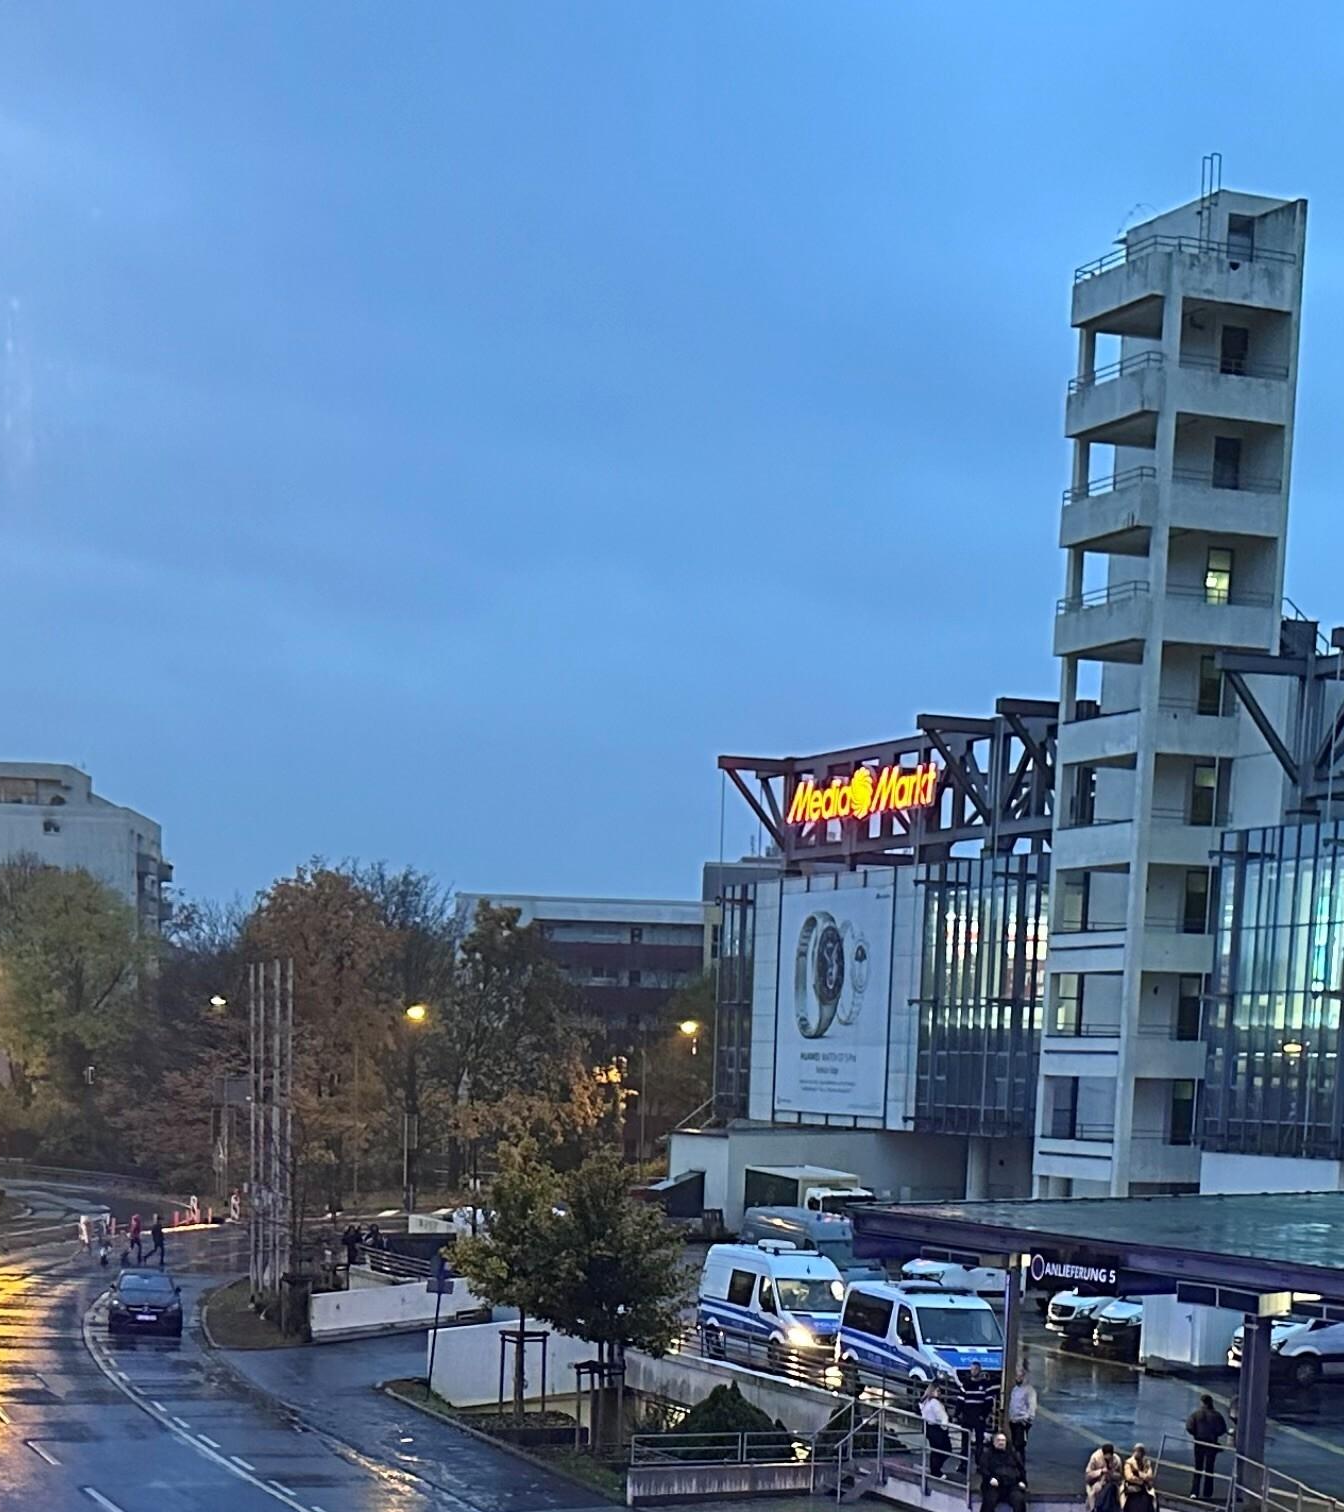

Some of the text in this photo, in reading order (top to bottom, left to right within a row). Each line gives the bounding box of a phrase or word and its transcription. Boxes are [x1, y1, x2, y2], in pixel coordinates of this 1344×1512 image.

[787, 762, 937, 825] Media Markt
[1045, 1262, 1116, 1284] ANLIEFERUNG 5
